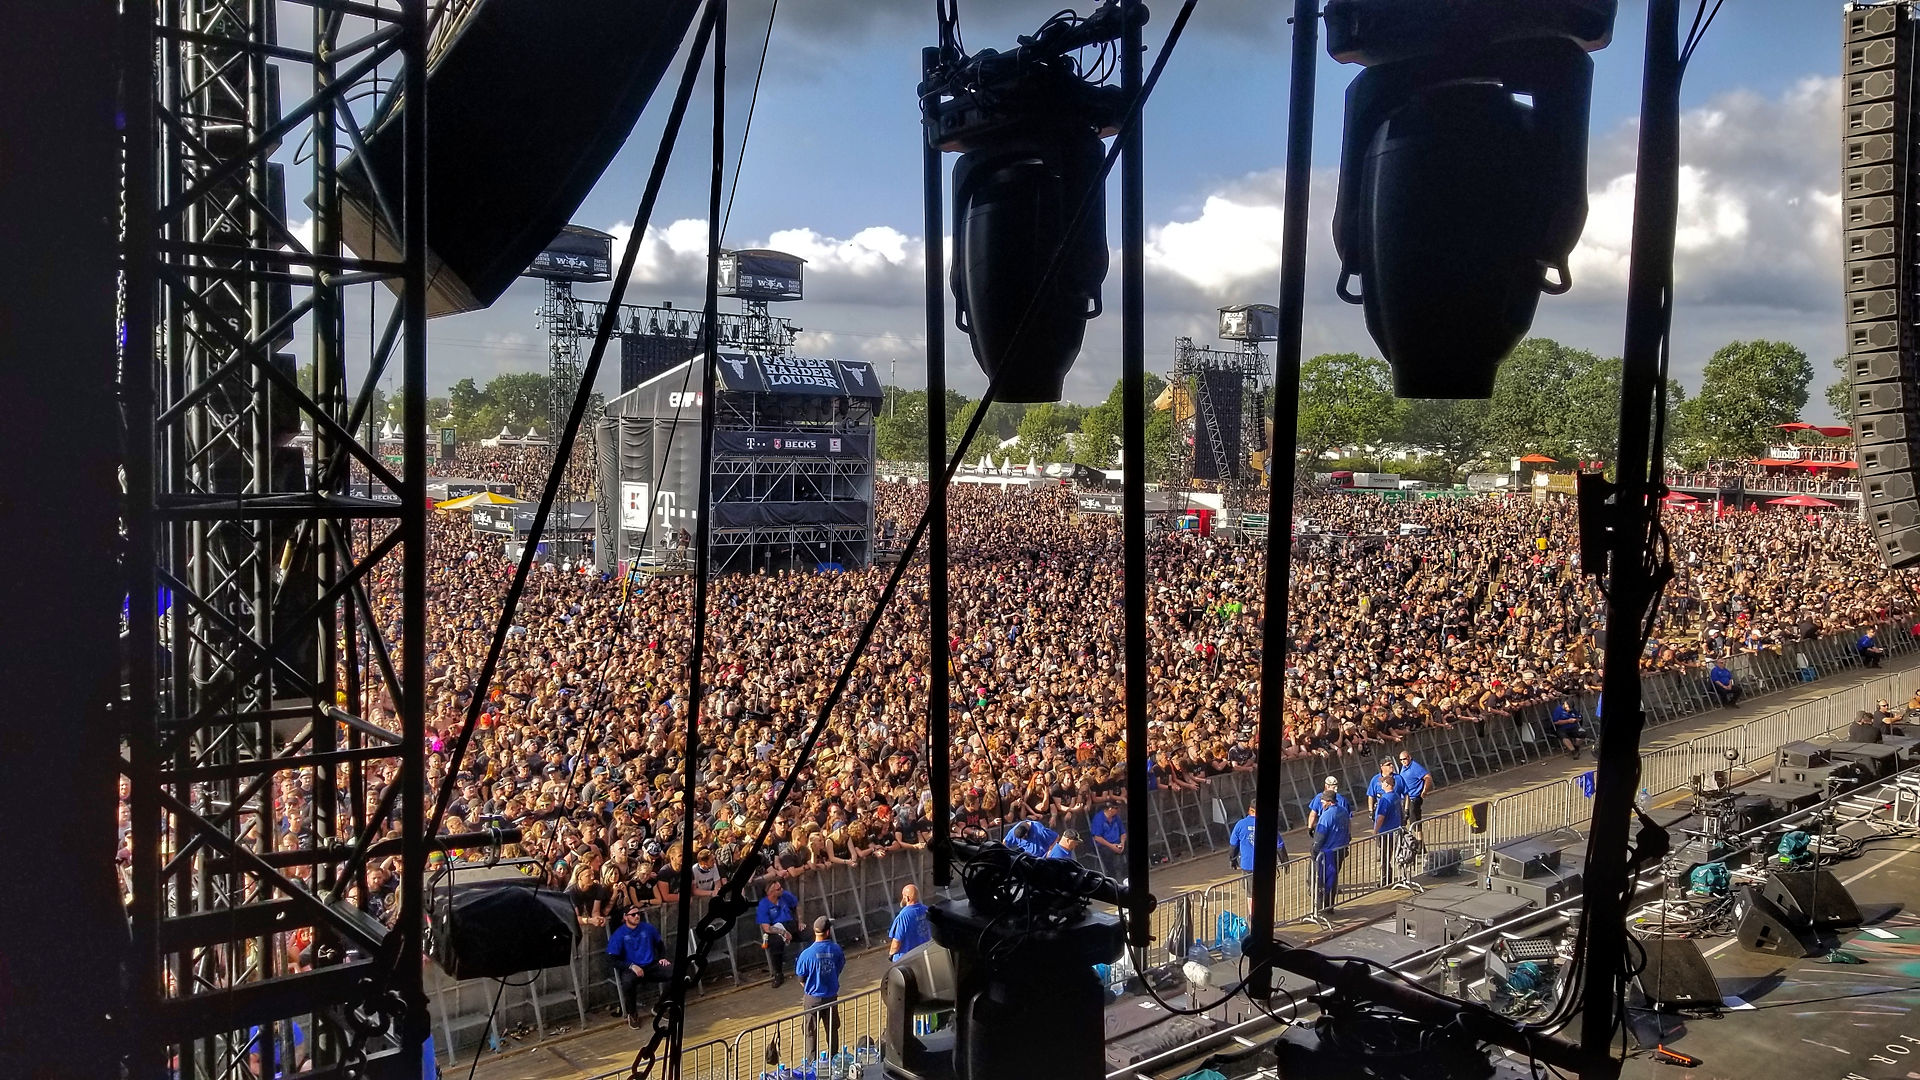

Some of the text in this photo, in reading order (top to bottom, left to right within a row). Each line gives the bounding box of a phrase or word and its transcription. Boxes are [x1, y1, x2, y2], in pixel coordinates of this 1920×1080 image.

[761, 355, 829, 368] FASTER
[764, 364, 834, 378] HARDER
[768, 374, 840, 390] LOUDER
